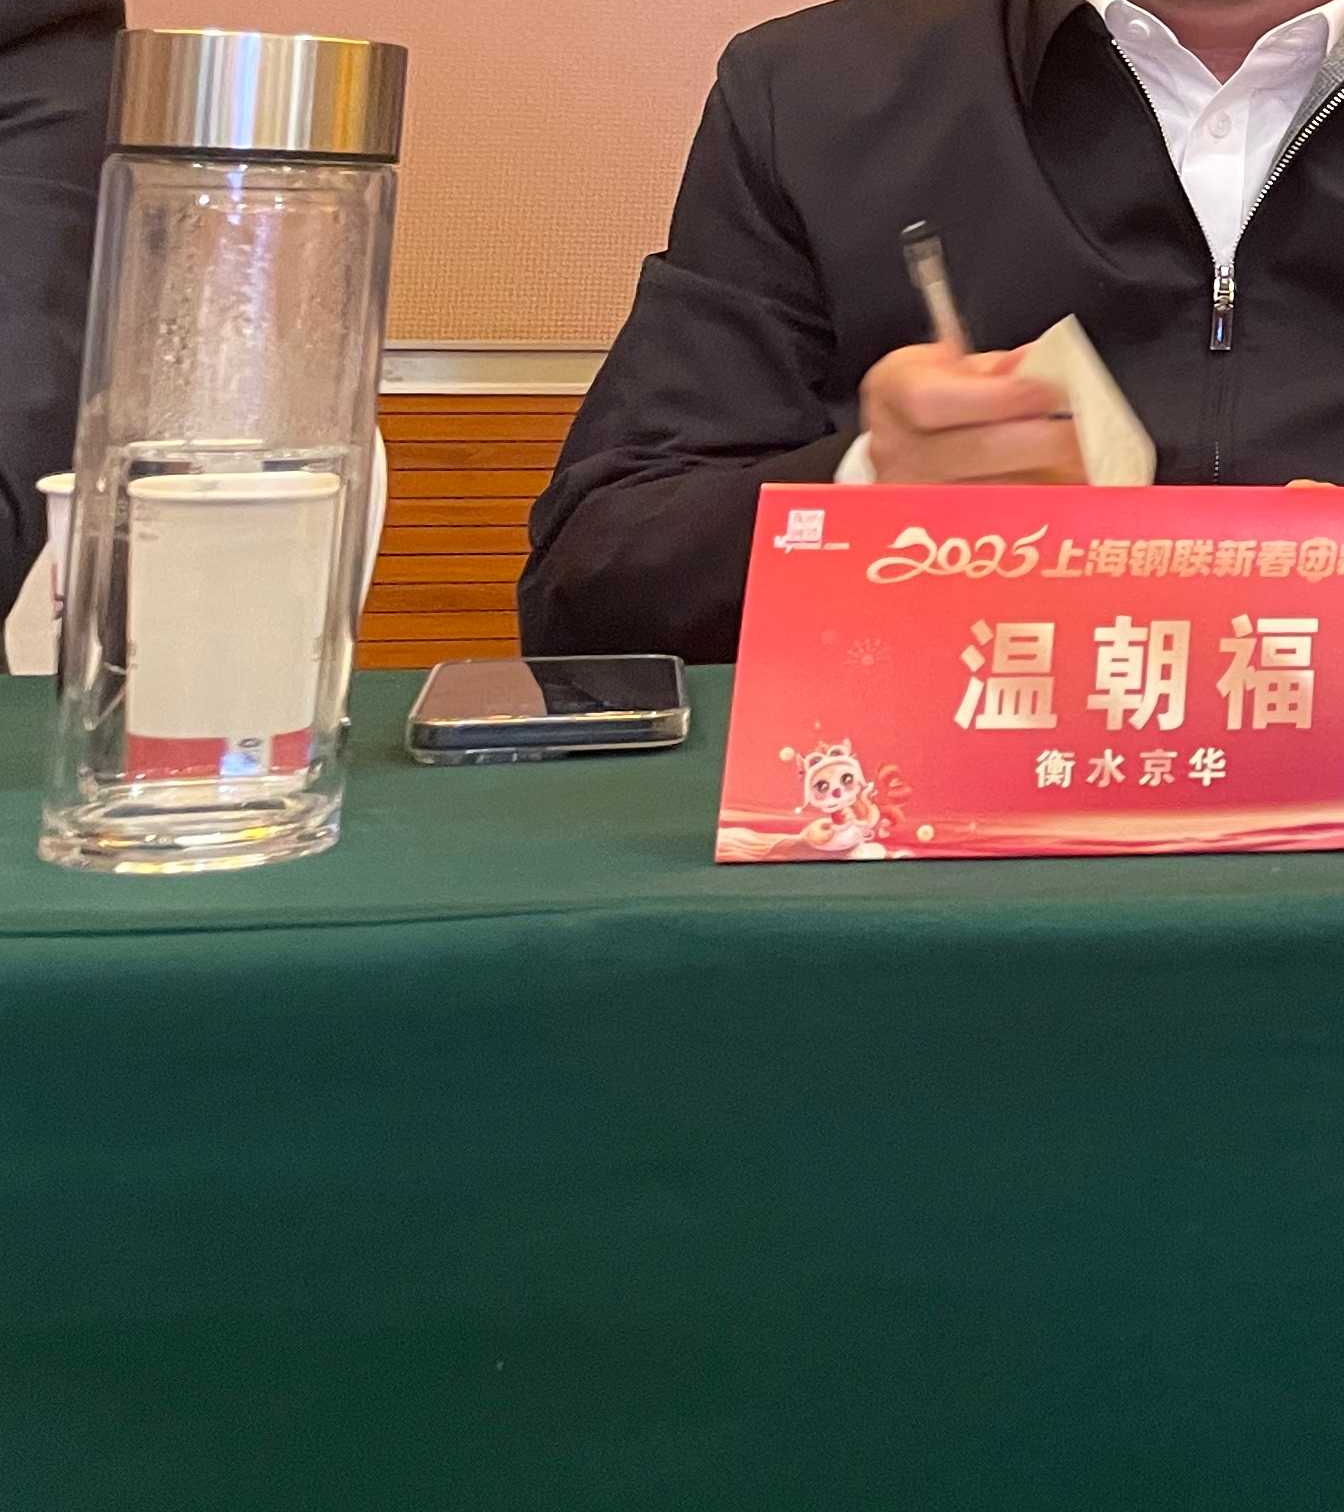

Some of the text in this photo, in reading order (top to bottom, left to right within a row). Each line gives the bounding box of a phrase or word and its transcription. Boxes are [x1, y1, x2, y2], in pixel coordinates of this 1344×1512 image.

[954, 614, 1319, 731] 温朝福
[1034, 746, 1227, 789] 衡水京华
